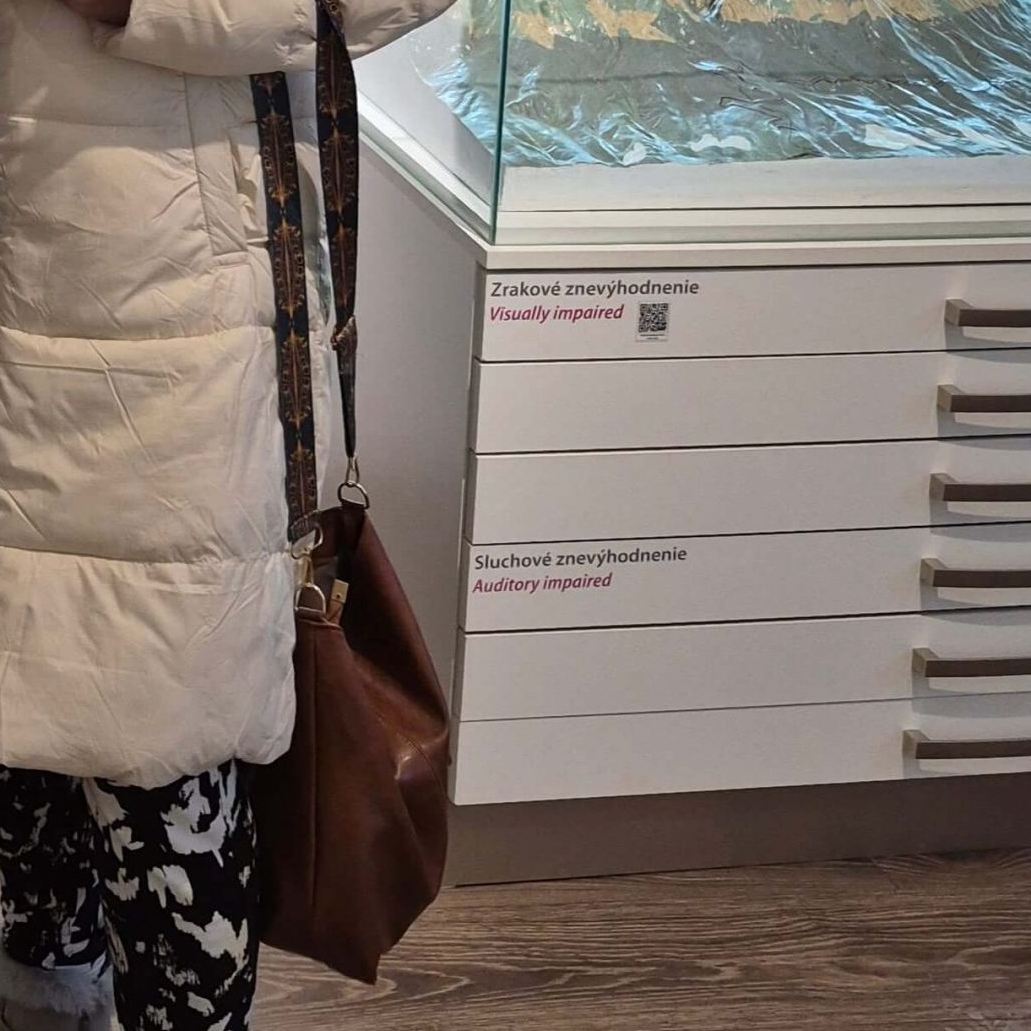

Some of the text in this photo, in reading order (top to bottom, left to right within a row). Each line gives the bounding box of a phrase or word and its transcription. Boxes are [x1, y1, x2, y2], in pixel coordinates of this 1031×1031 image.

[490, 279, 699, 299] Zrakové znevýhodnenie
[489, 304, 625, 323] Visually impaired
[474, 547, 687, 570] Sluchové znevýhodnenie
[472, 573, 613, 594] Auditory impaired
